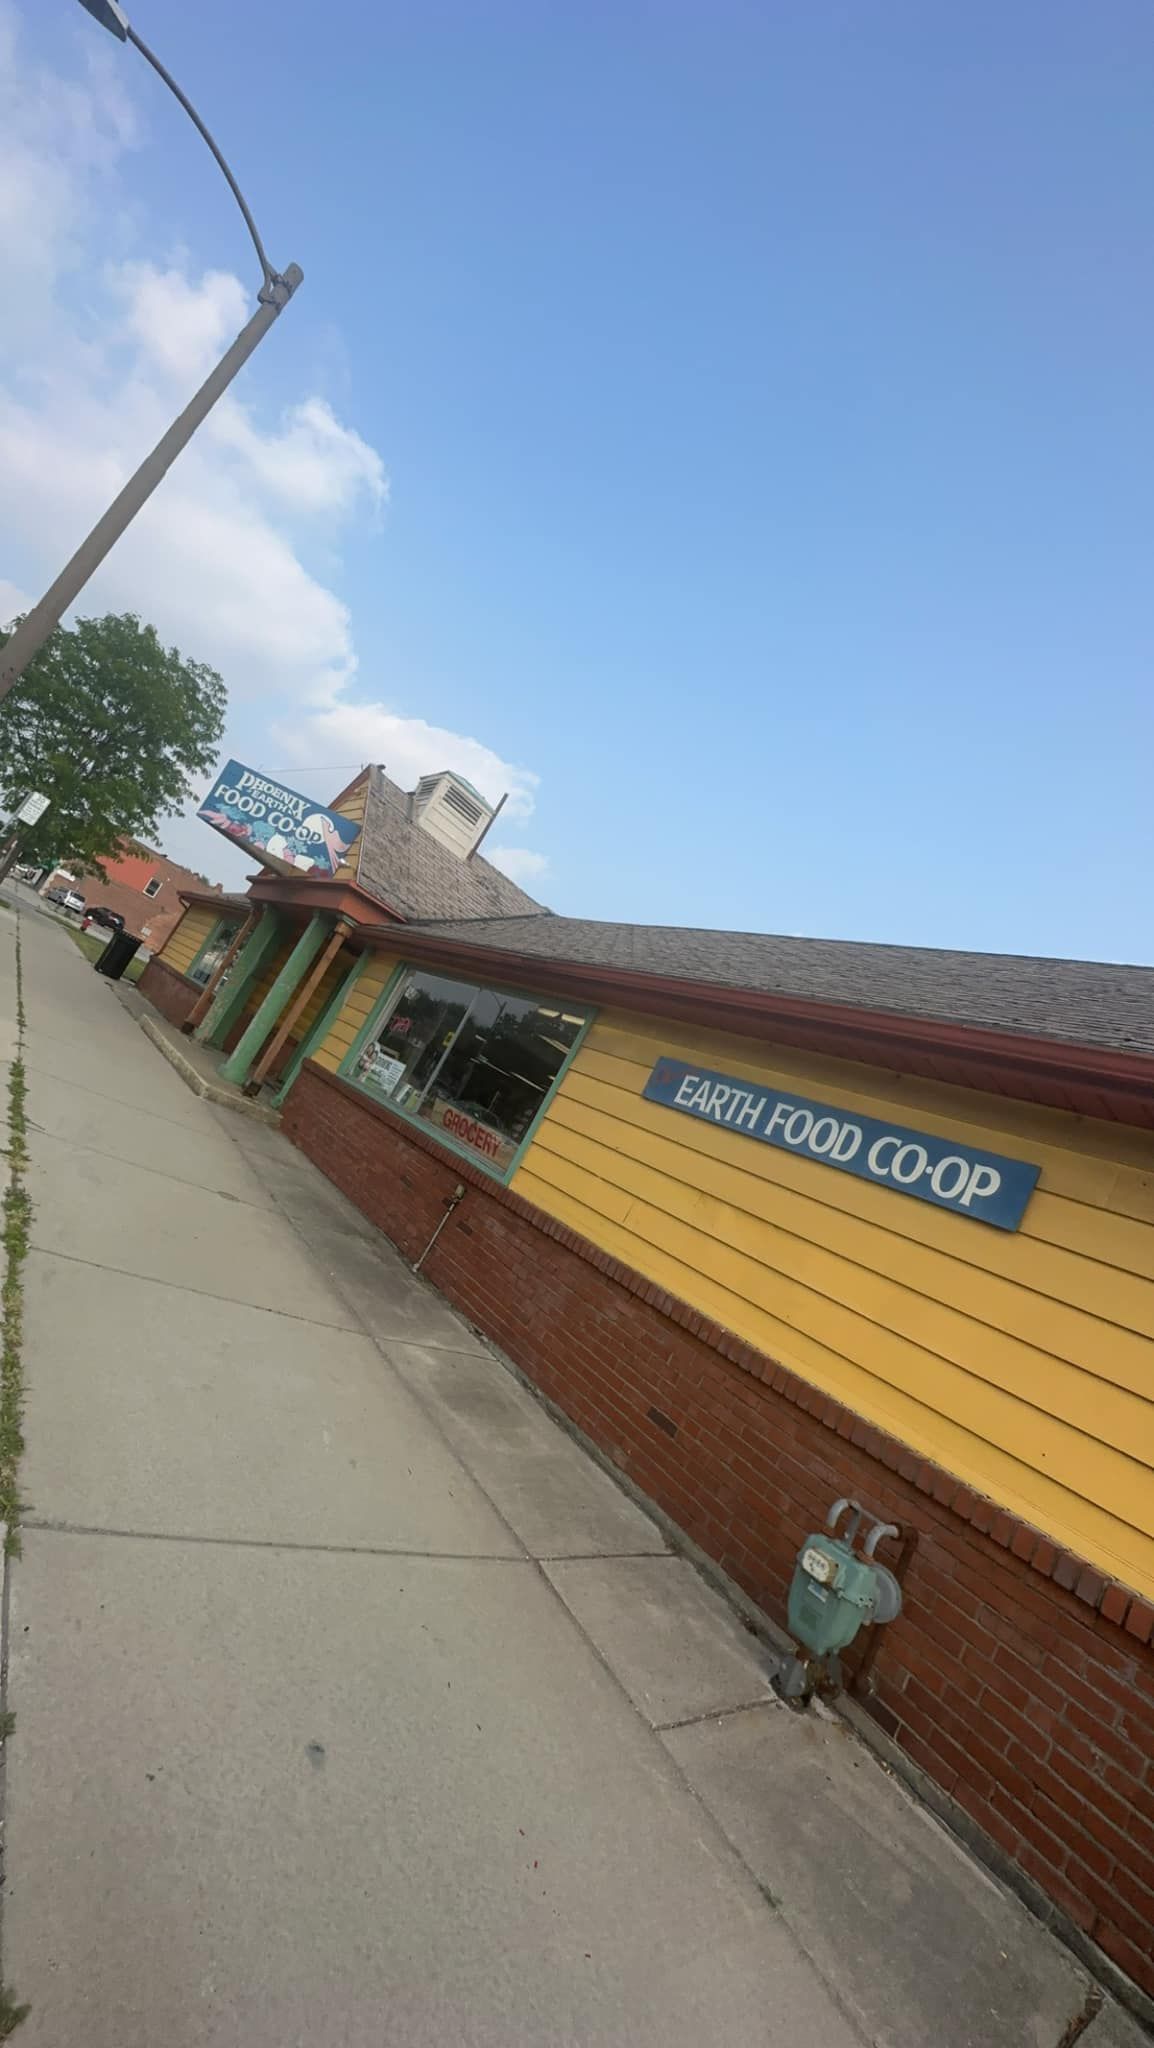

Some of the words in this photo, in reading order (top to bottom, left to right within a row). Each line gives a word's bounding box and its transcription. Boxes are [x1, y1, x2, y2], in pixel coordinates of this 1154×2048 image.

[214, 784, 266, 818] FOOD
[235, 771, 310, 821] PHOENIX
[250, 789, 288, 814] EARTH
[442, 1108, 501, 1157] GROCERY
[674, 1074, 768, 1130] EARTH
[764, 1102, 863, 1163] FOOD
